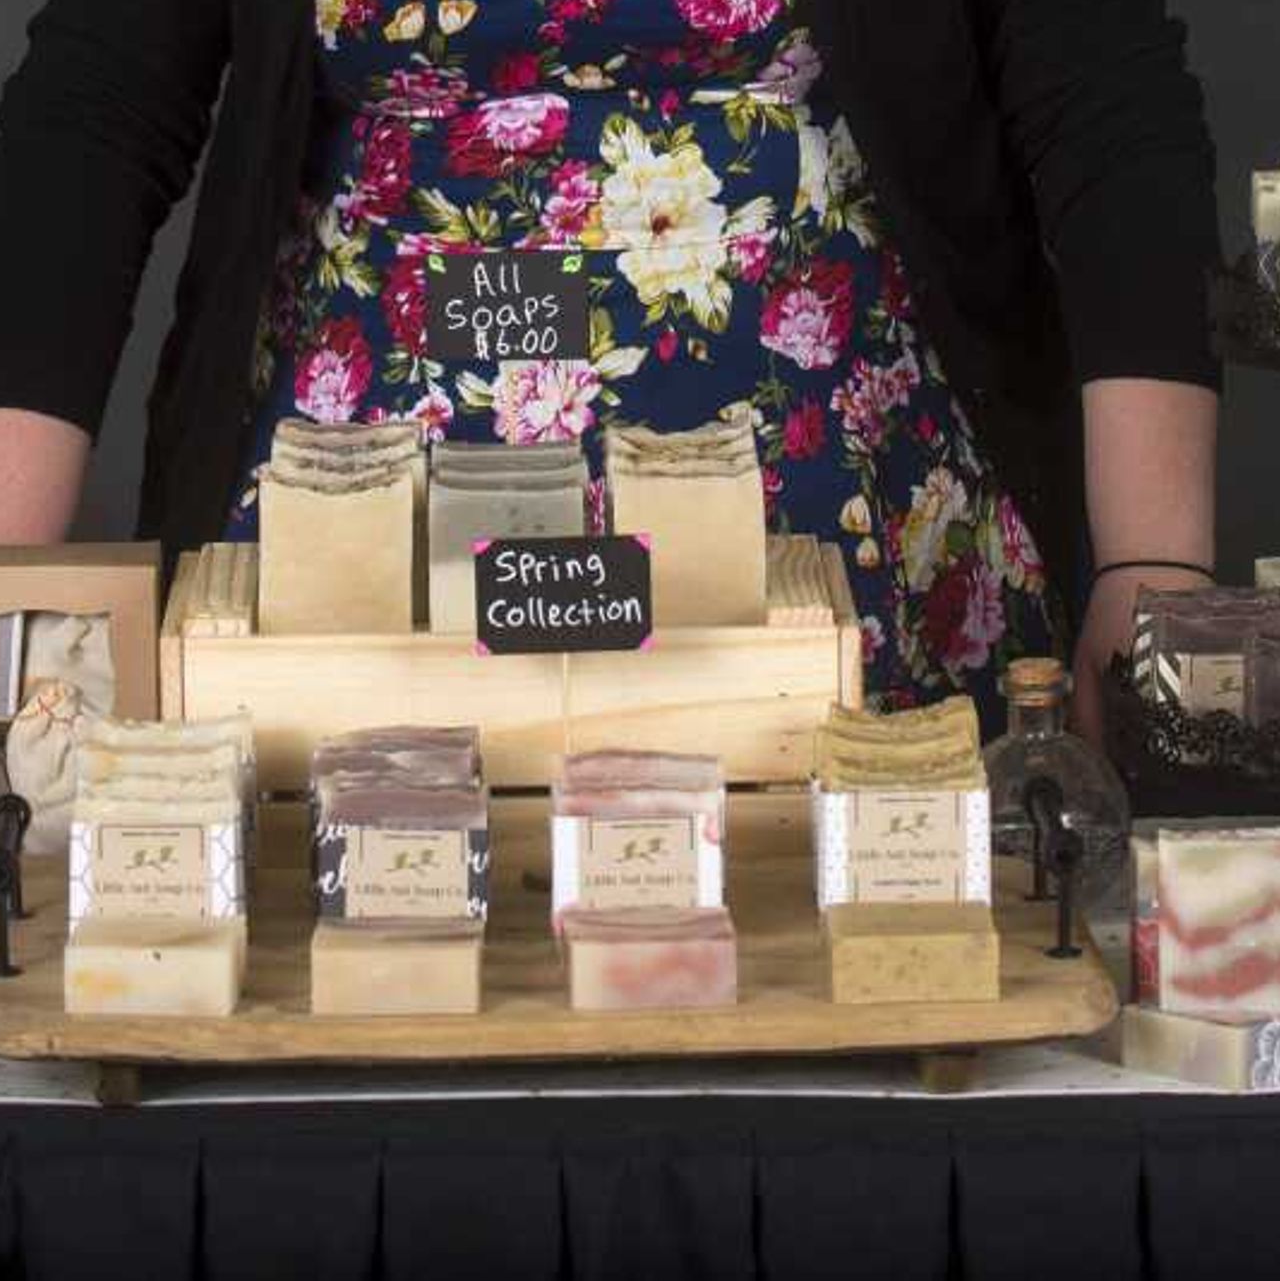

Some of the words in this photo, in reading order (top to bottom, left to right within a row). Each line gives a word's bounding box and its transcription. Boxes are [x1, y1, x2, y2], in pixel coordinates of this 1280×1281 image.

[473, 261, 521, 298] All
[445, 293, 559, 331] Soaps
[474, 326, 558, 361] $6.00
[486, 593, 642, 628] Collection
